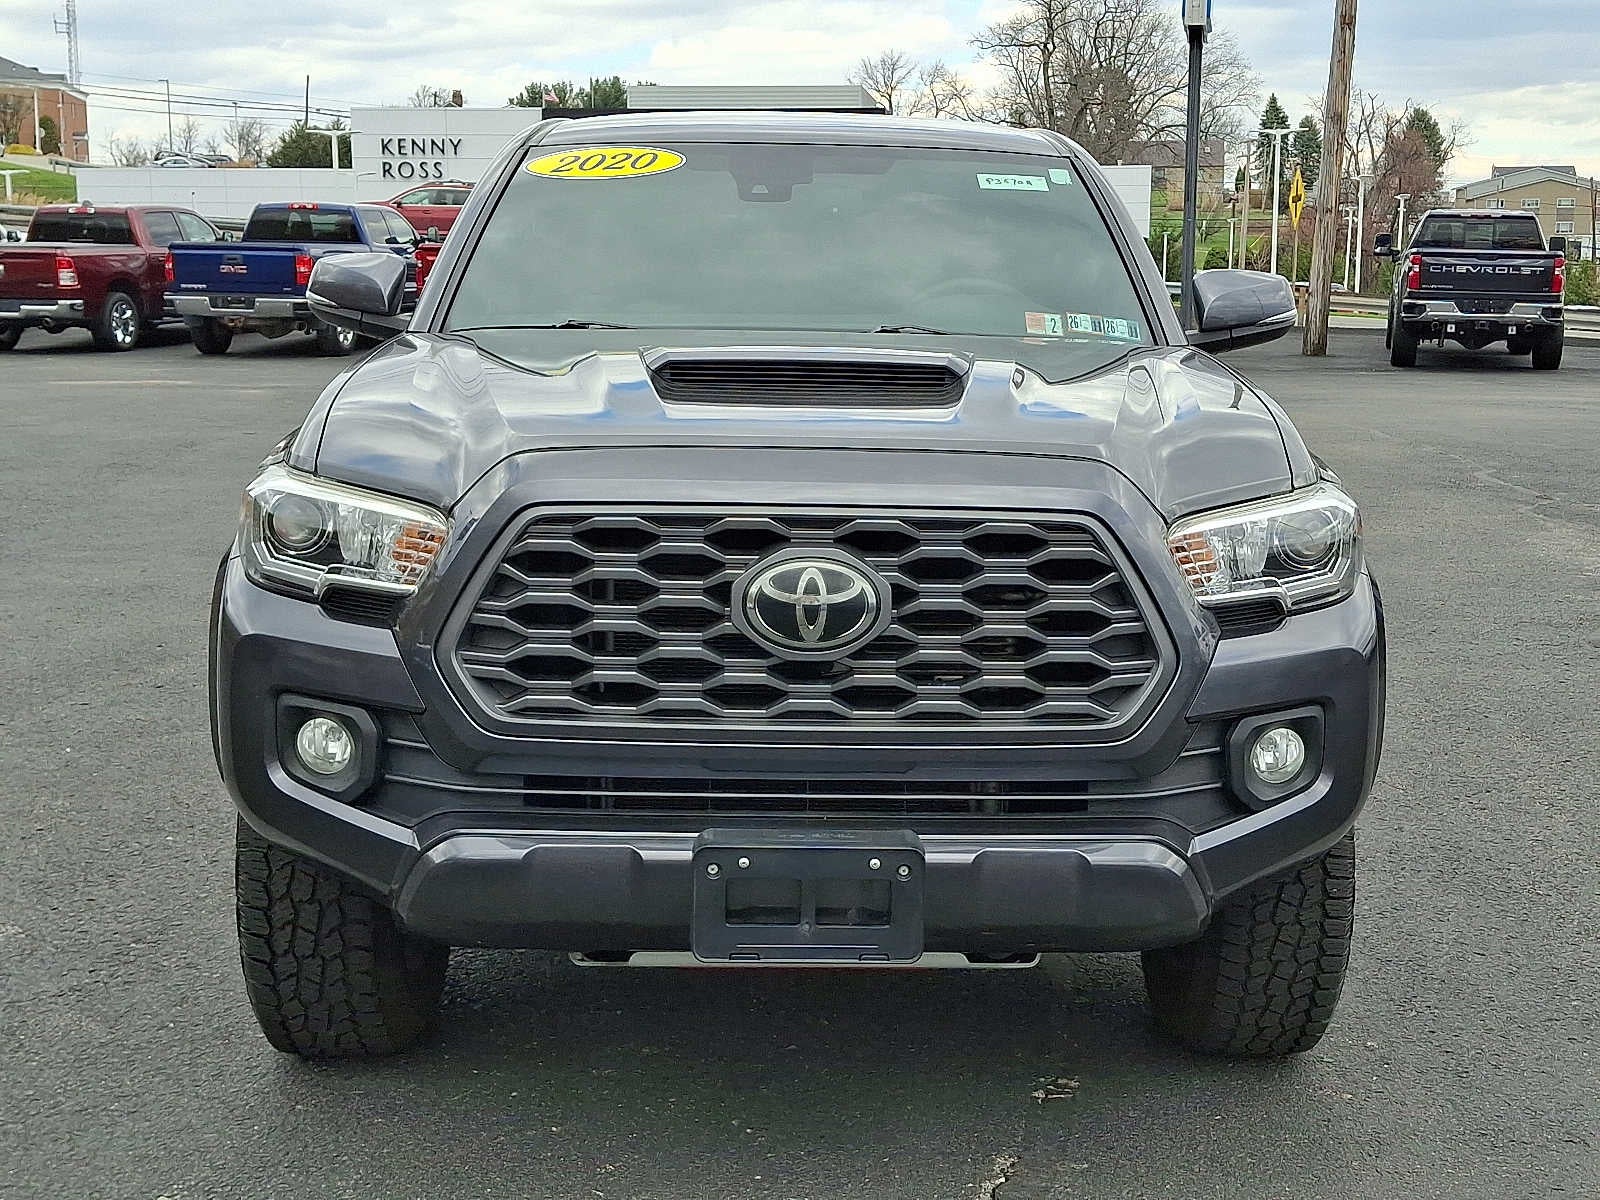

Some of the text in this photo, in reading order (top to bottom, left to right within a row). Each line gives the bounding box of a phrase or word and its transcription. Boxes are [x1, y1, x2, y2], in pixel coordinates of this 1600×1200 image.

[381, 138, 462, 156] KENNY
[382, 161, 443, 179] ROSS
[550, 152, 658, 173] 2020
[1429, 265, 1545, 275] CHEVROLET
[1050, 318, 1058, 333] 2
[1068, 315, 1079, 329] 26
[1105, 320, 1116, 334] 26
